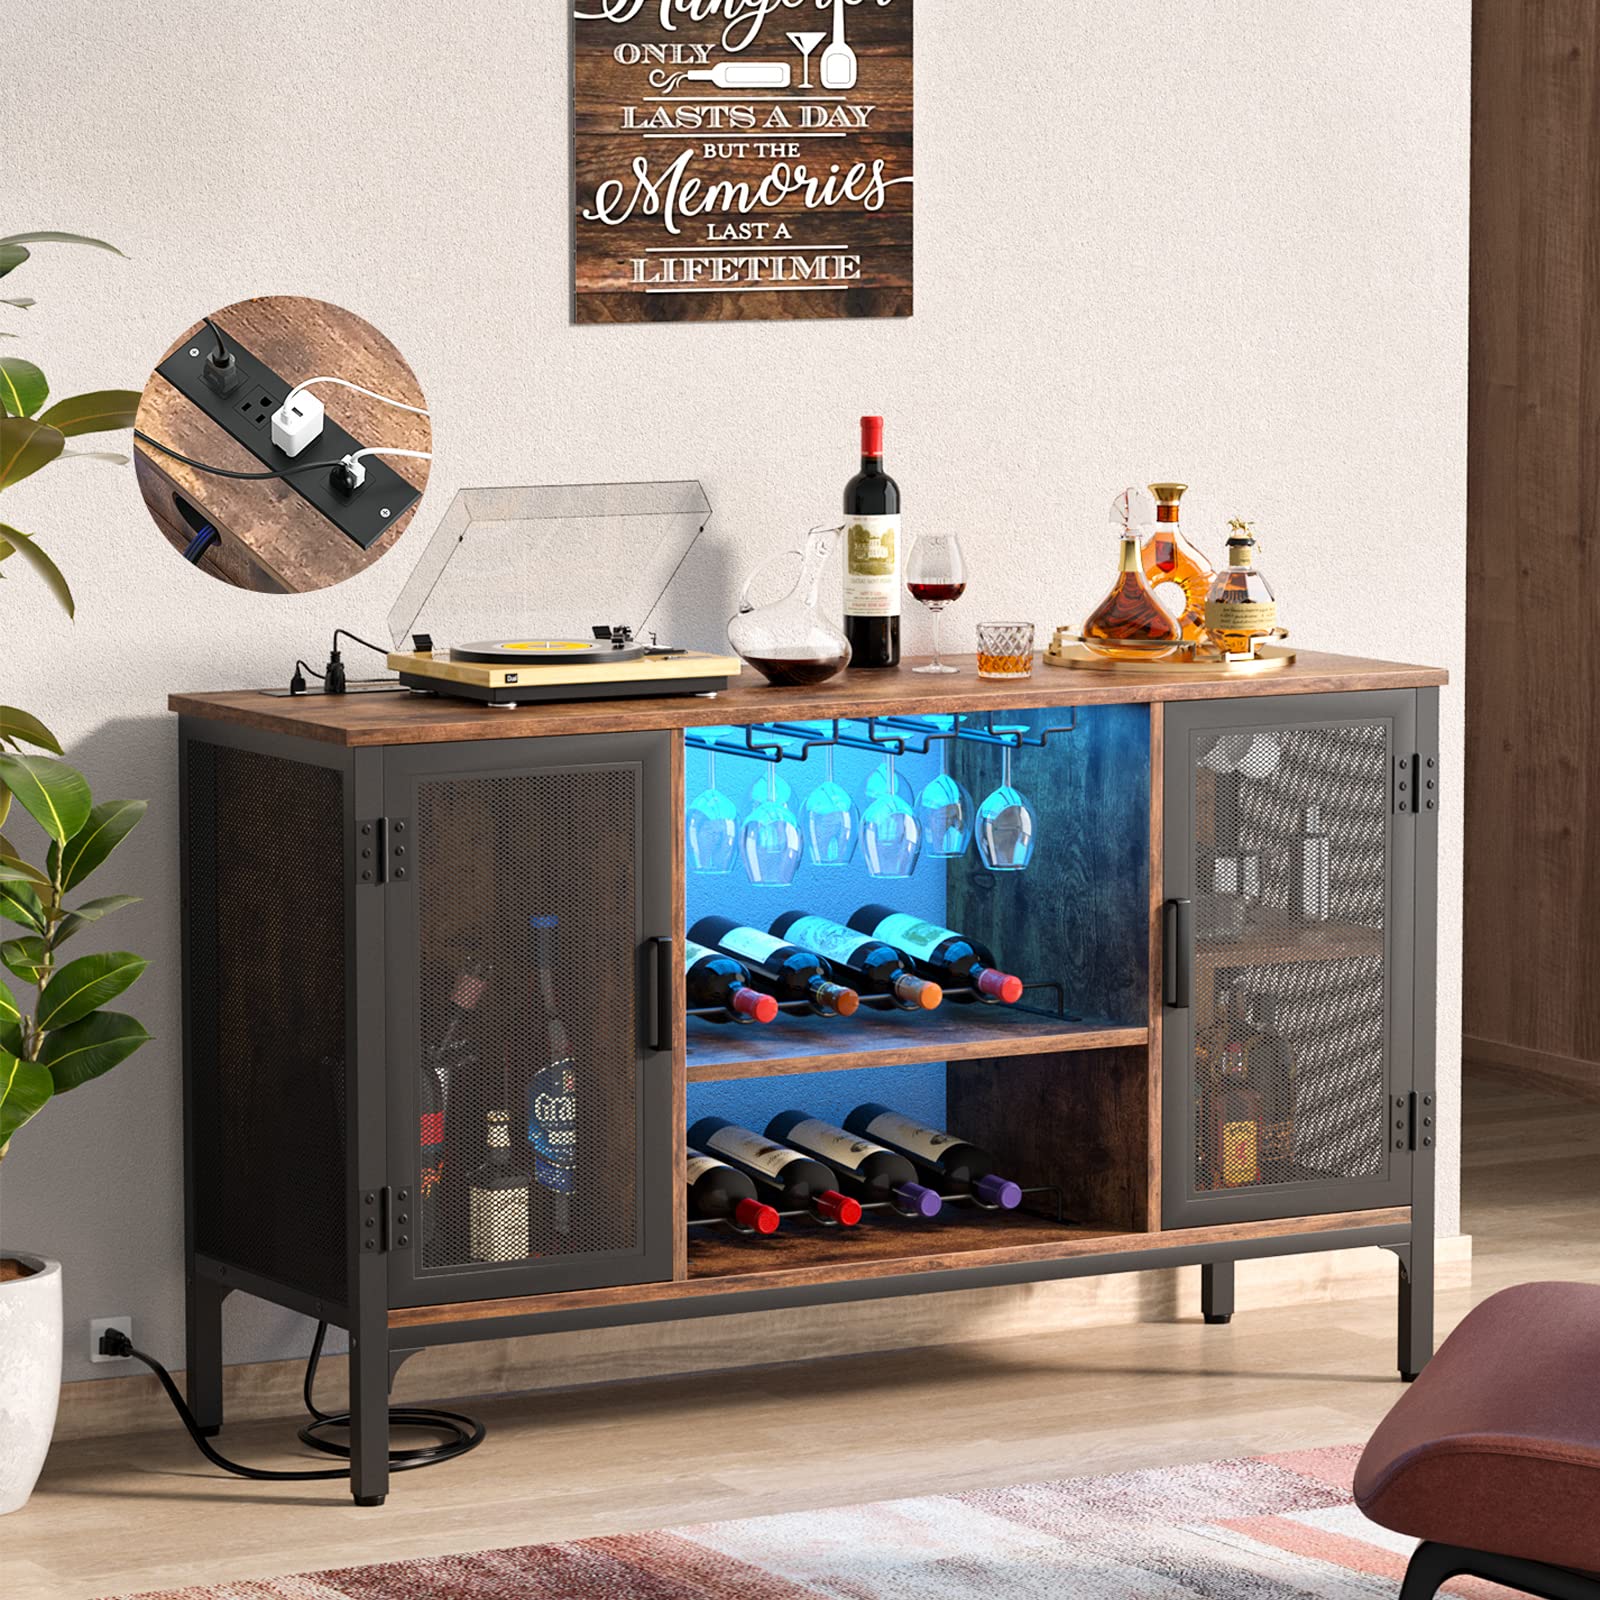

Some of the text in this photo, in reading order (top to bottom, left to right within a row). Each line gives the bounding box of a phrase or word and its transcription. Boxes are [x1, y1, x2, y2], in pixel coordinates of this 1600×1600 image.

[614, 43, 716, 65] ONLY
[621, 105, 875, 129] LASTS A DAY
[703, 142, 800, 159] BUT THE
[582, 149, 913, 235] Memories
[707, 222, 792, 240] LAST A
[630, 255, 861, 284] LIFETIME
